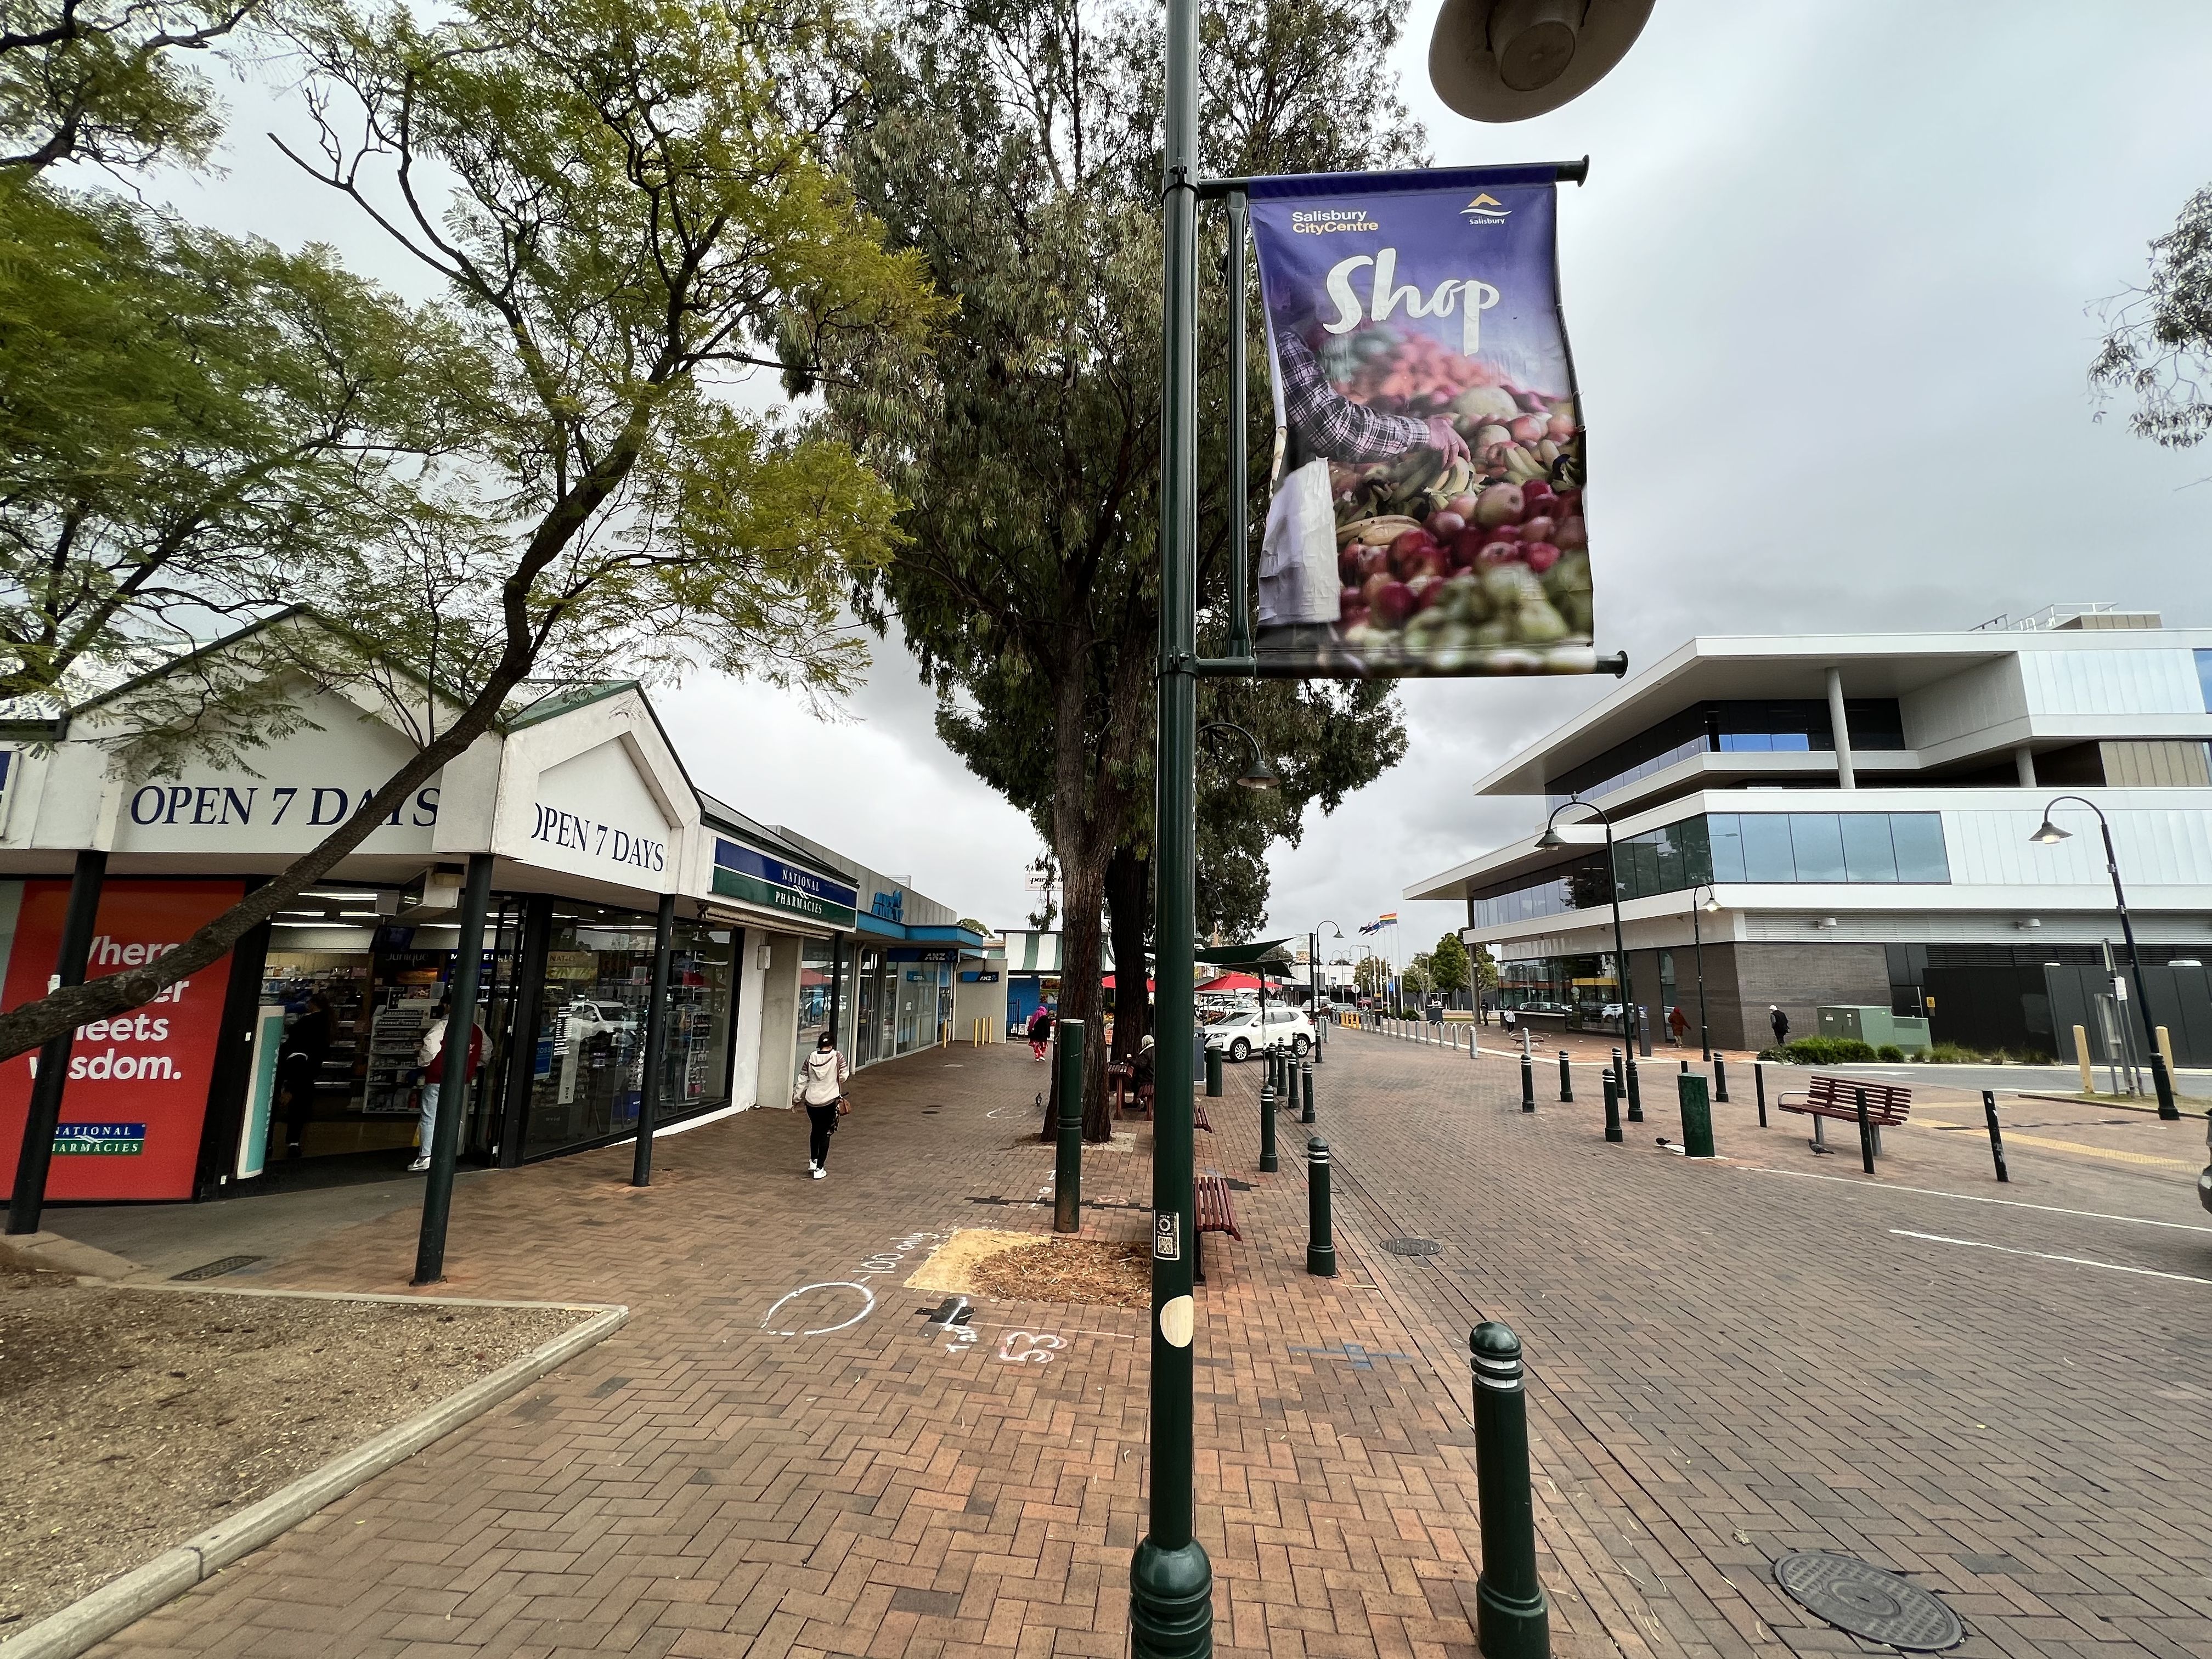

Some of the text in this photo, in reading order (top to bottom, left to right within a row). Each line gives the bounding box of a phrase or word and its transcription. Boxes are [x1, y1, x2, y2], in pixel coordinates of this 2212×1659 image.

[1292, 210, 1367, 222] Salisbury
[1293, 221, 1379, 235] CityCentre
[1323, 247, 1499, 356] Shop
[131, 786, 258, 825] OPEN
[272, 788, 298, 825] 7
[596, 824, 608, 855] 7
[612, 830, 664, 872] DAYS
[782, 870, 820, 892] NATIONAL
[775, 891, 822, 914] PHARMACIES
[29, 1048, 182, 1080] sdom.
[52, 1143, 138, 1152] ARMACIES
